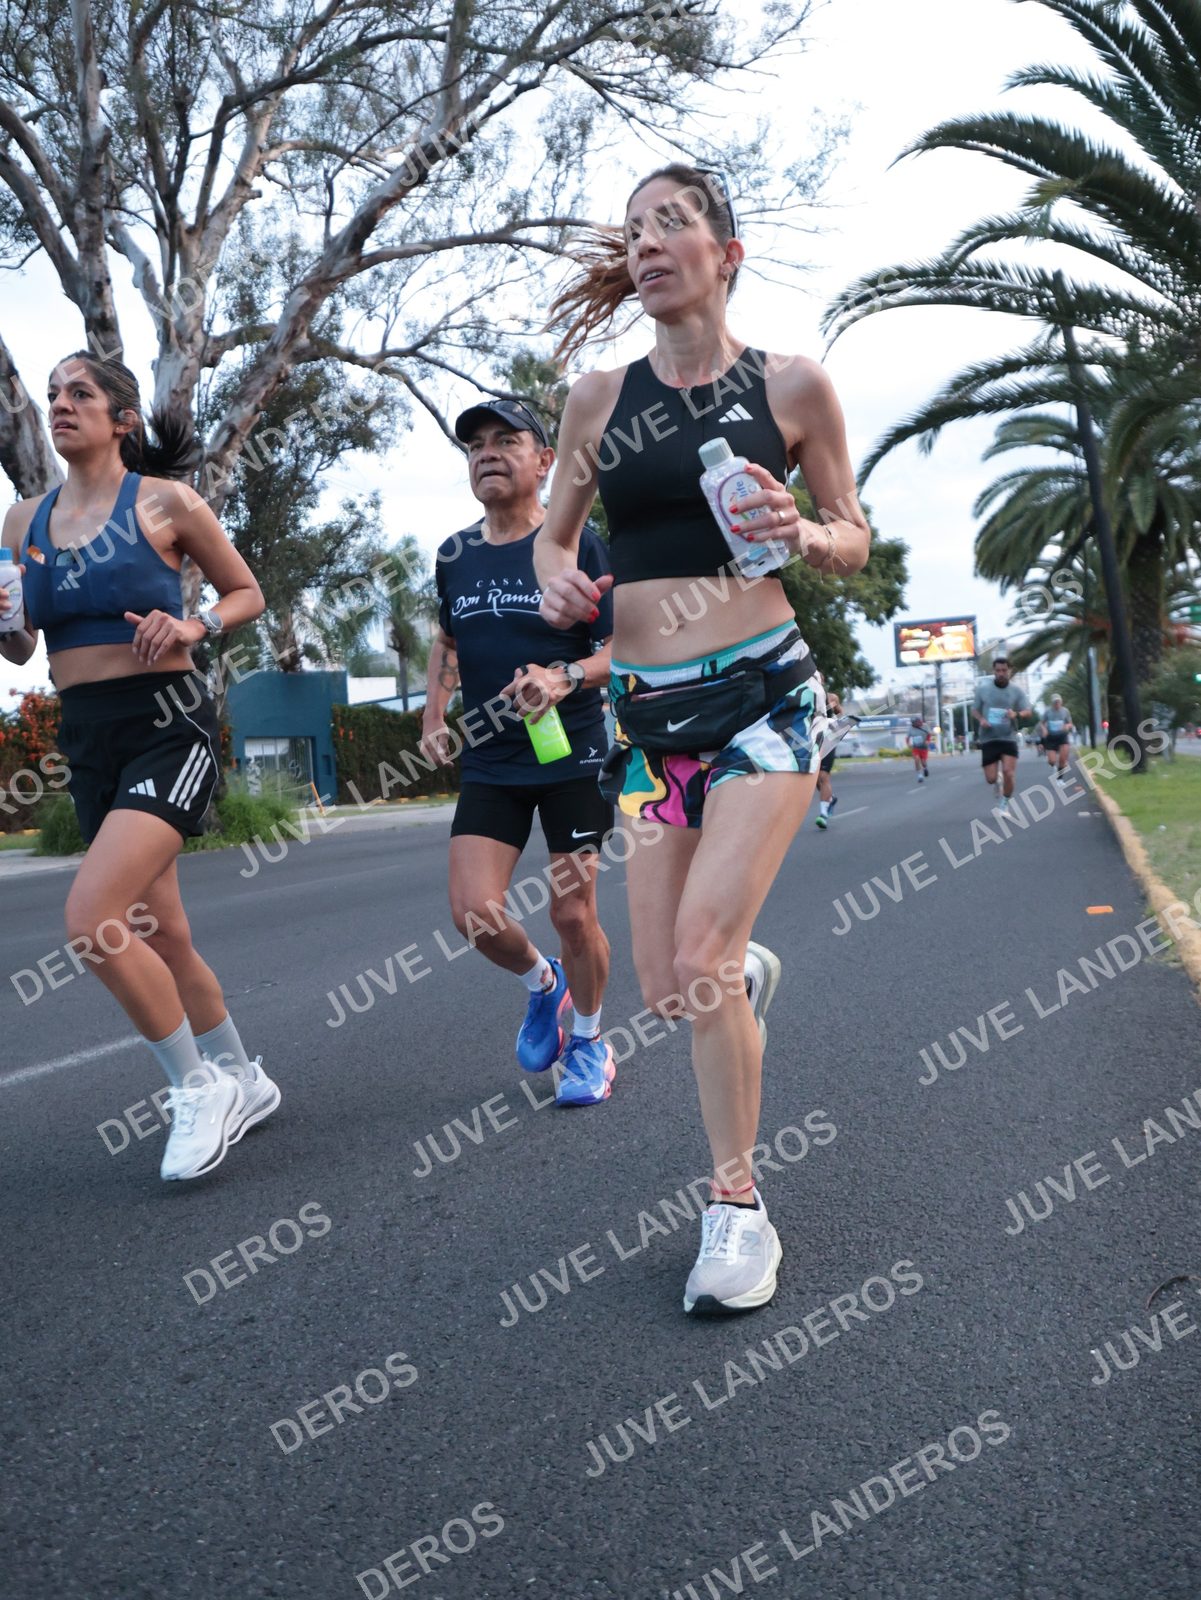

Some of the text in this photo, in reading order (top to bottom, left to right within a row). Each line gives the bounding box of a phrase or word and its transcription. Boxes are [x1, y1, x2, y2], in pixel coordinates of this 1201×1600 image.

[476, 578, 523, 588] CASA
[452, 588, 544, 618] Don Ramó
